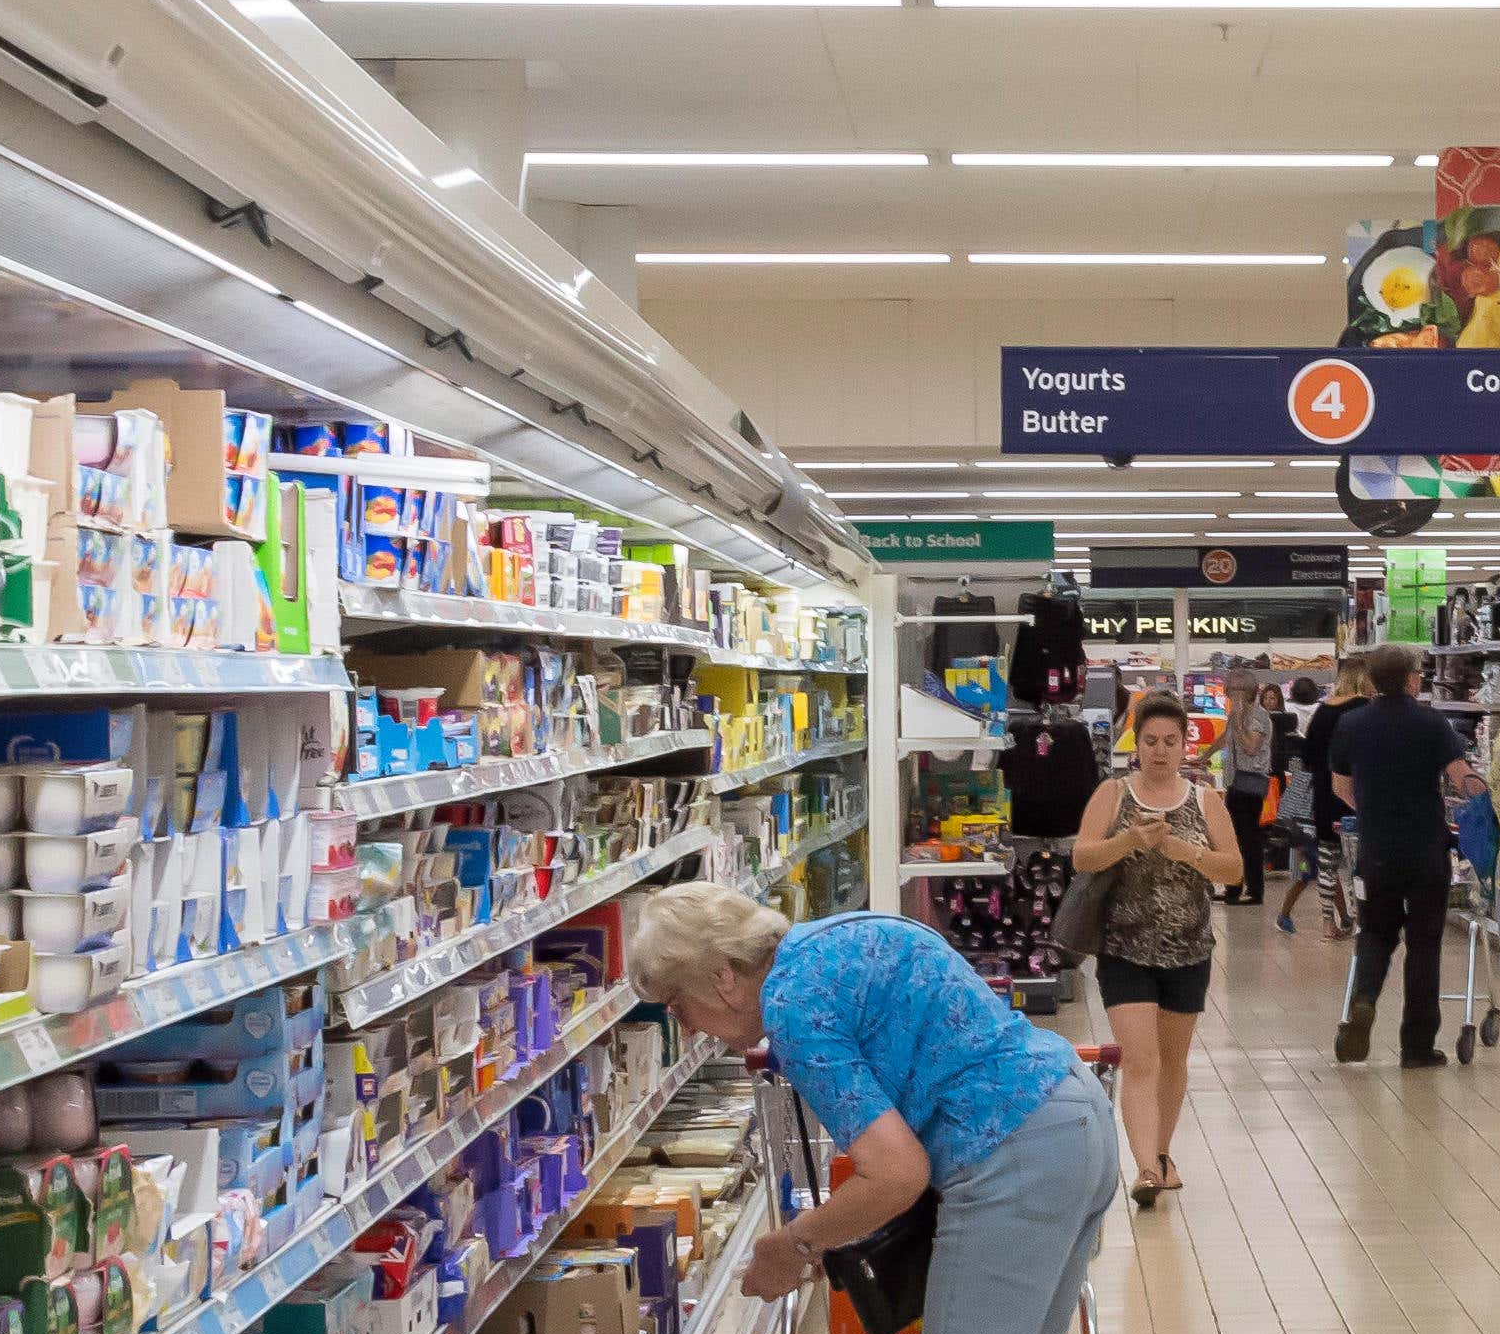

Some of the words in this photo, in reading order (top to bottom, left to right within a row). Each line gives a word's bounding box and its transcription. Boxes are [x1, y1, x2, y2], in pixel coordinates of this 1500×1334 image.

[1022, 366, 1126, 396] Yogurts
[1311, 380, 1345, 419] 4
[1022, 409, 1109, 434] Butter
[859, 533, 901, 548] Back
[904, 533, 923, 548] to
[926, 532, 982, 548] School
[1136, 616, 1258, 635] PEKINS
